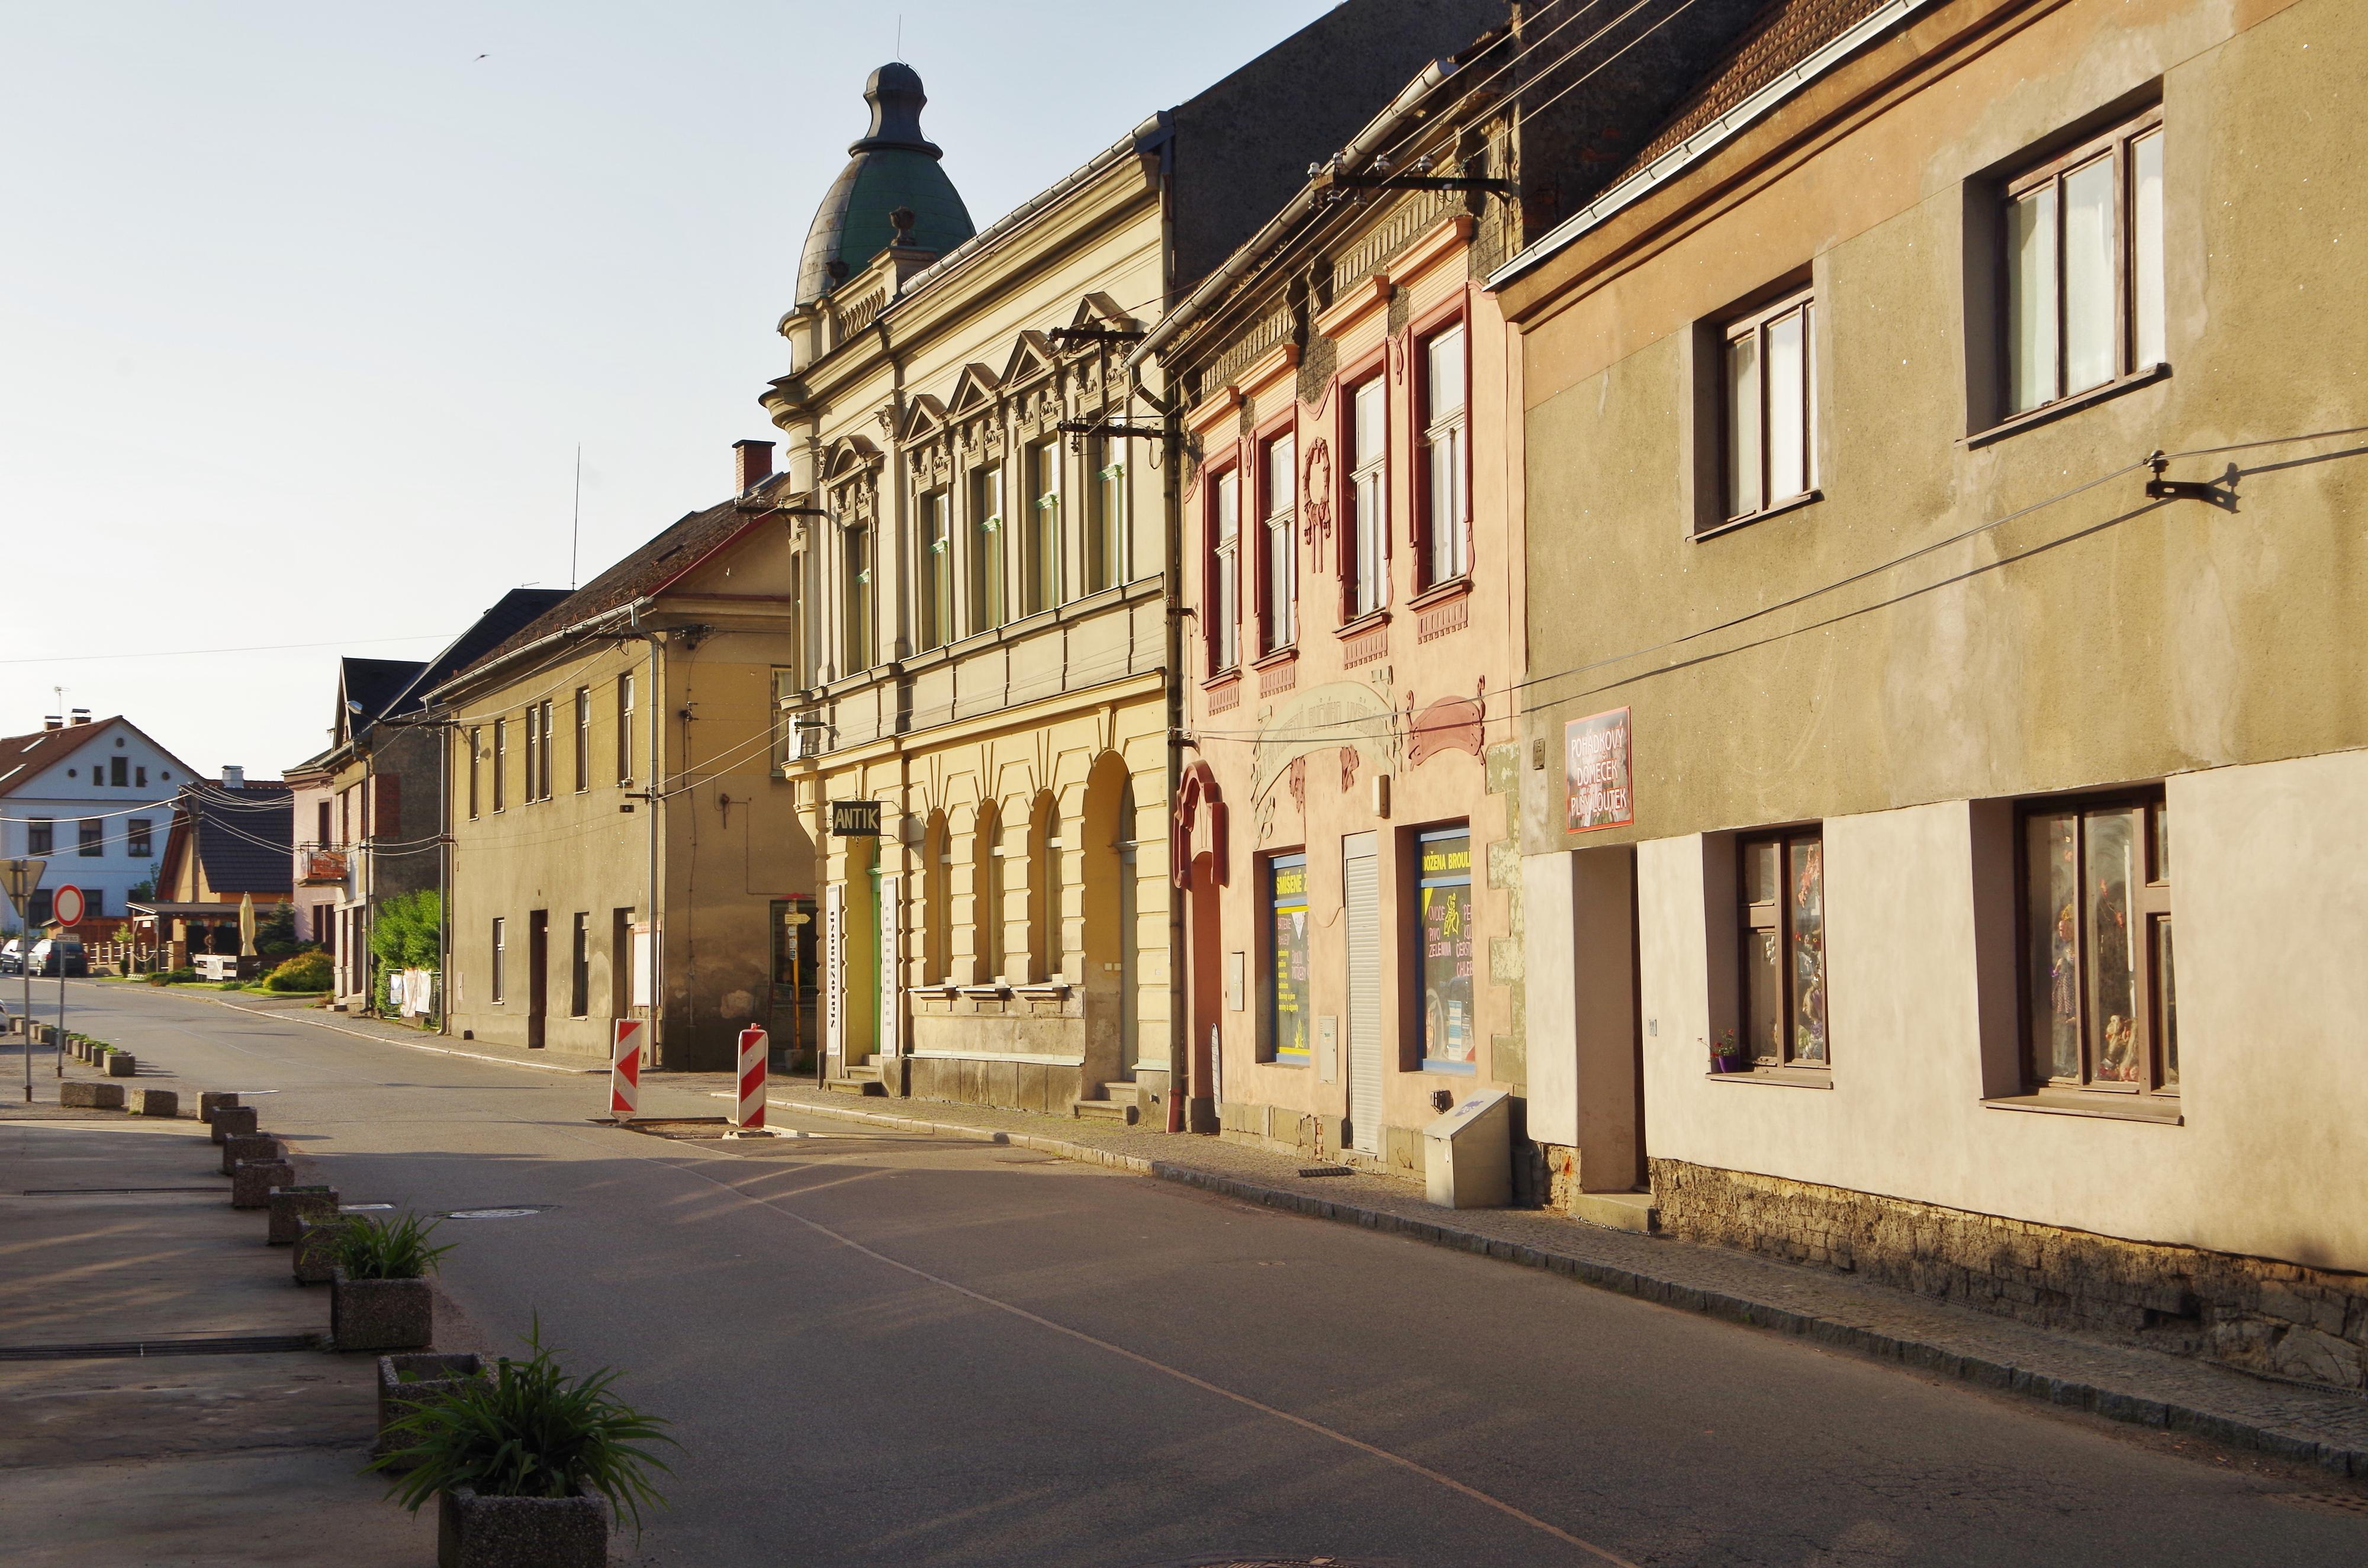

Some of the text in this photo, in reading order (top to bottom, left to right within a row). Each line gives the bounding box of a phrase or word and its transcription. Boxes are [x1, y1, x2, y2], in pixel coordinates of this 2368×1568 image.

[1571, 718, 1624, 759] POHÁDKOVÝ
[1576, 755, 1619, 787] DOMEČEK
[1592, 788, 1627, 813] LOUTEK
[834, 808, 879, 829] ANTIK
[1276, 869, 1302, 895] SMÍŠENÉ
[1428, 906, 1446, 921] OVOCE
[1428, 927, 1440, 942] PIVO
[1428, 941, 1451, 958] ZELENINA
